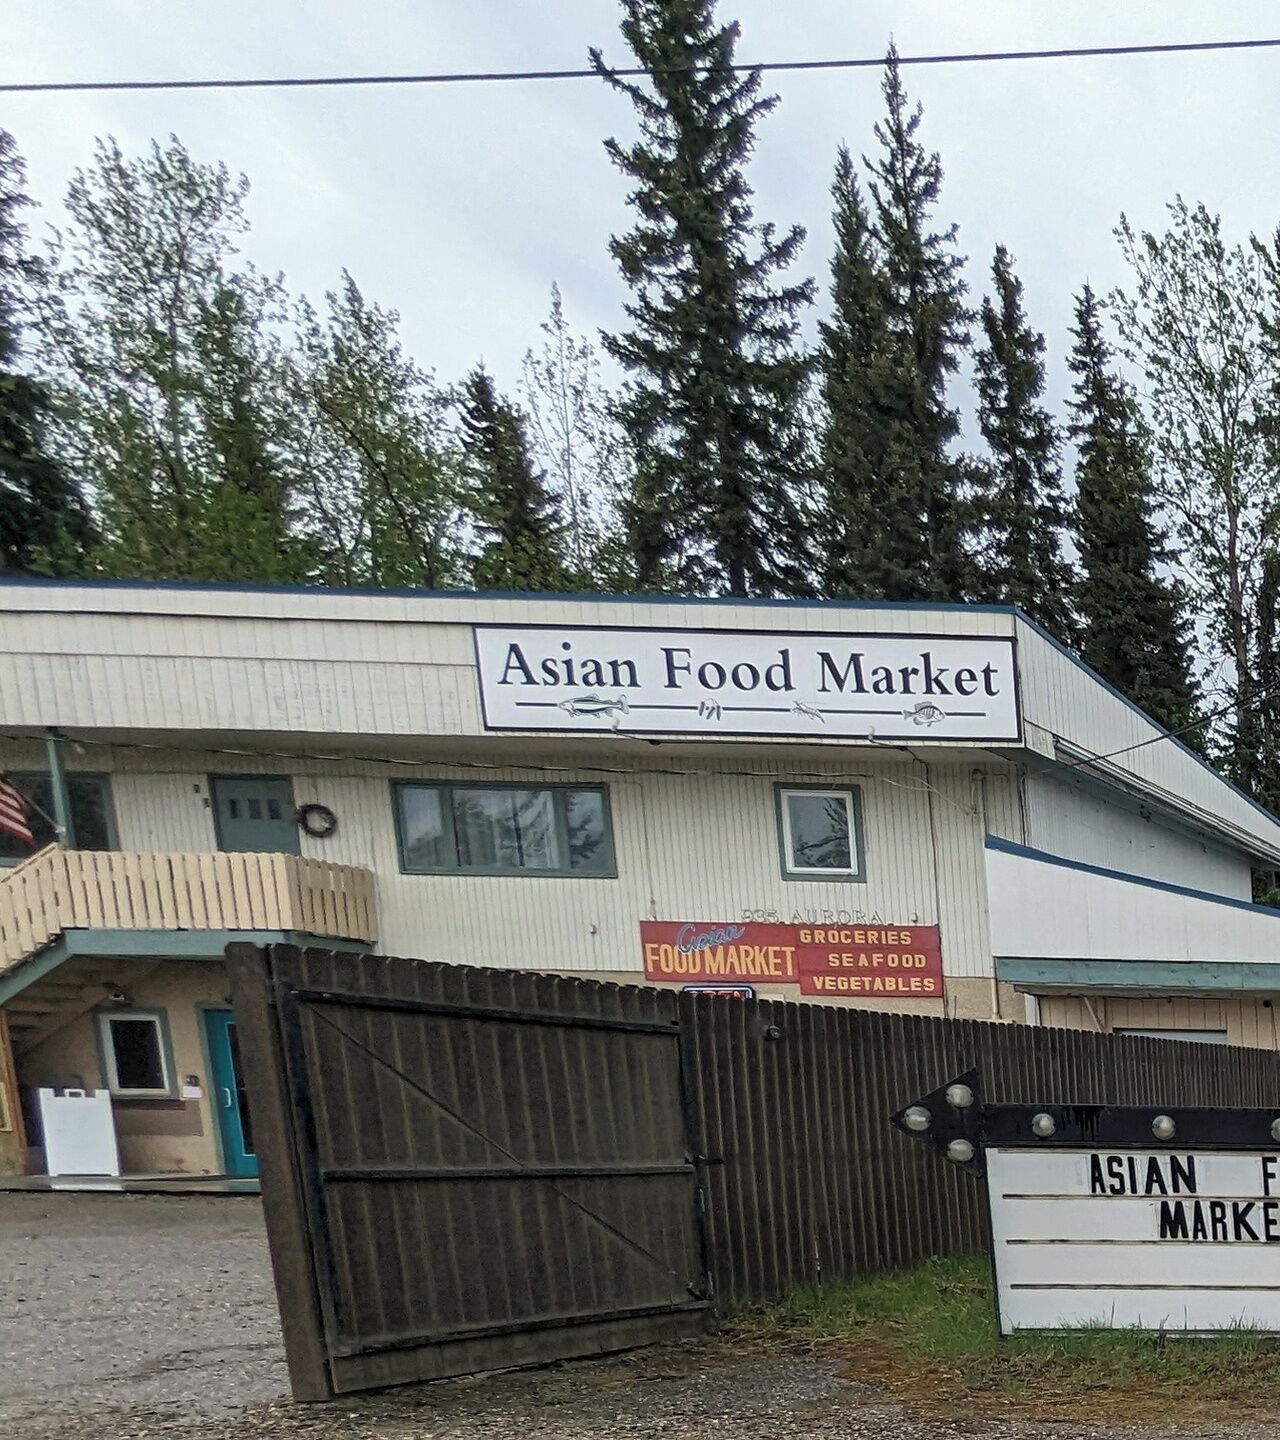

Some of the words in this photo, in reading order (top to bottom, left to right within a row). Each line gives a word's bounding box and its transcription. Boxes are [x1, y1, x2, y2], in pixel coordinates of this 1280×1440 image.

[497, 641, 641, 688] Asian
[661, 647, 796, 692] Food
[817, 650, 1001, 697] Market
[791, 908, 884, 925] AURORA
[800, 929, 912, 945] GROCERIES
[645, 943, 701, 974] FOOD
[705, 946, 796, 977] MARKET
[828, 953, 927, 969] SEAFOOD
[812, 976, 936, 992] VEGETABLES
[1091, 1154, 1197, 1195] ASIAN
